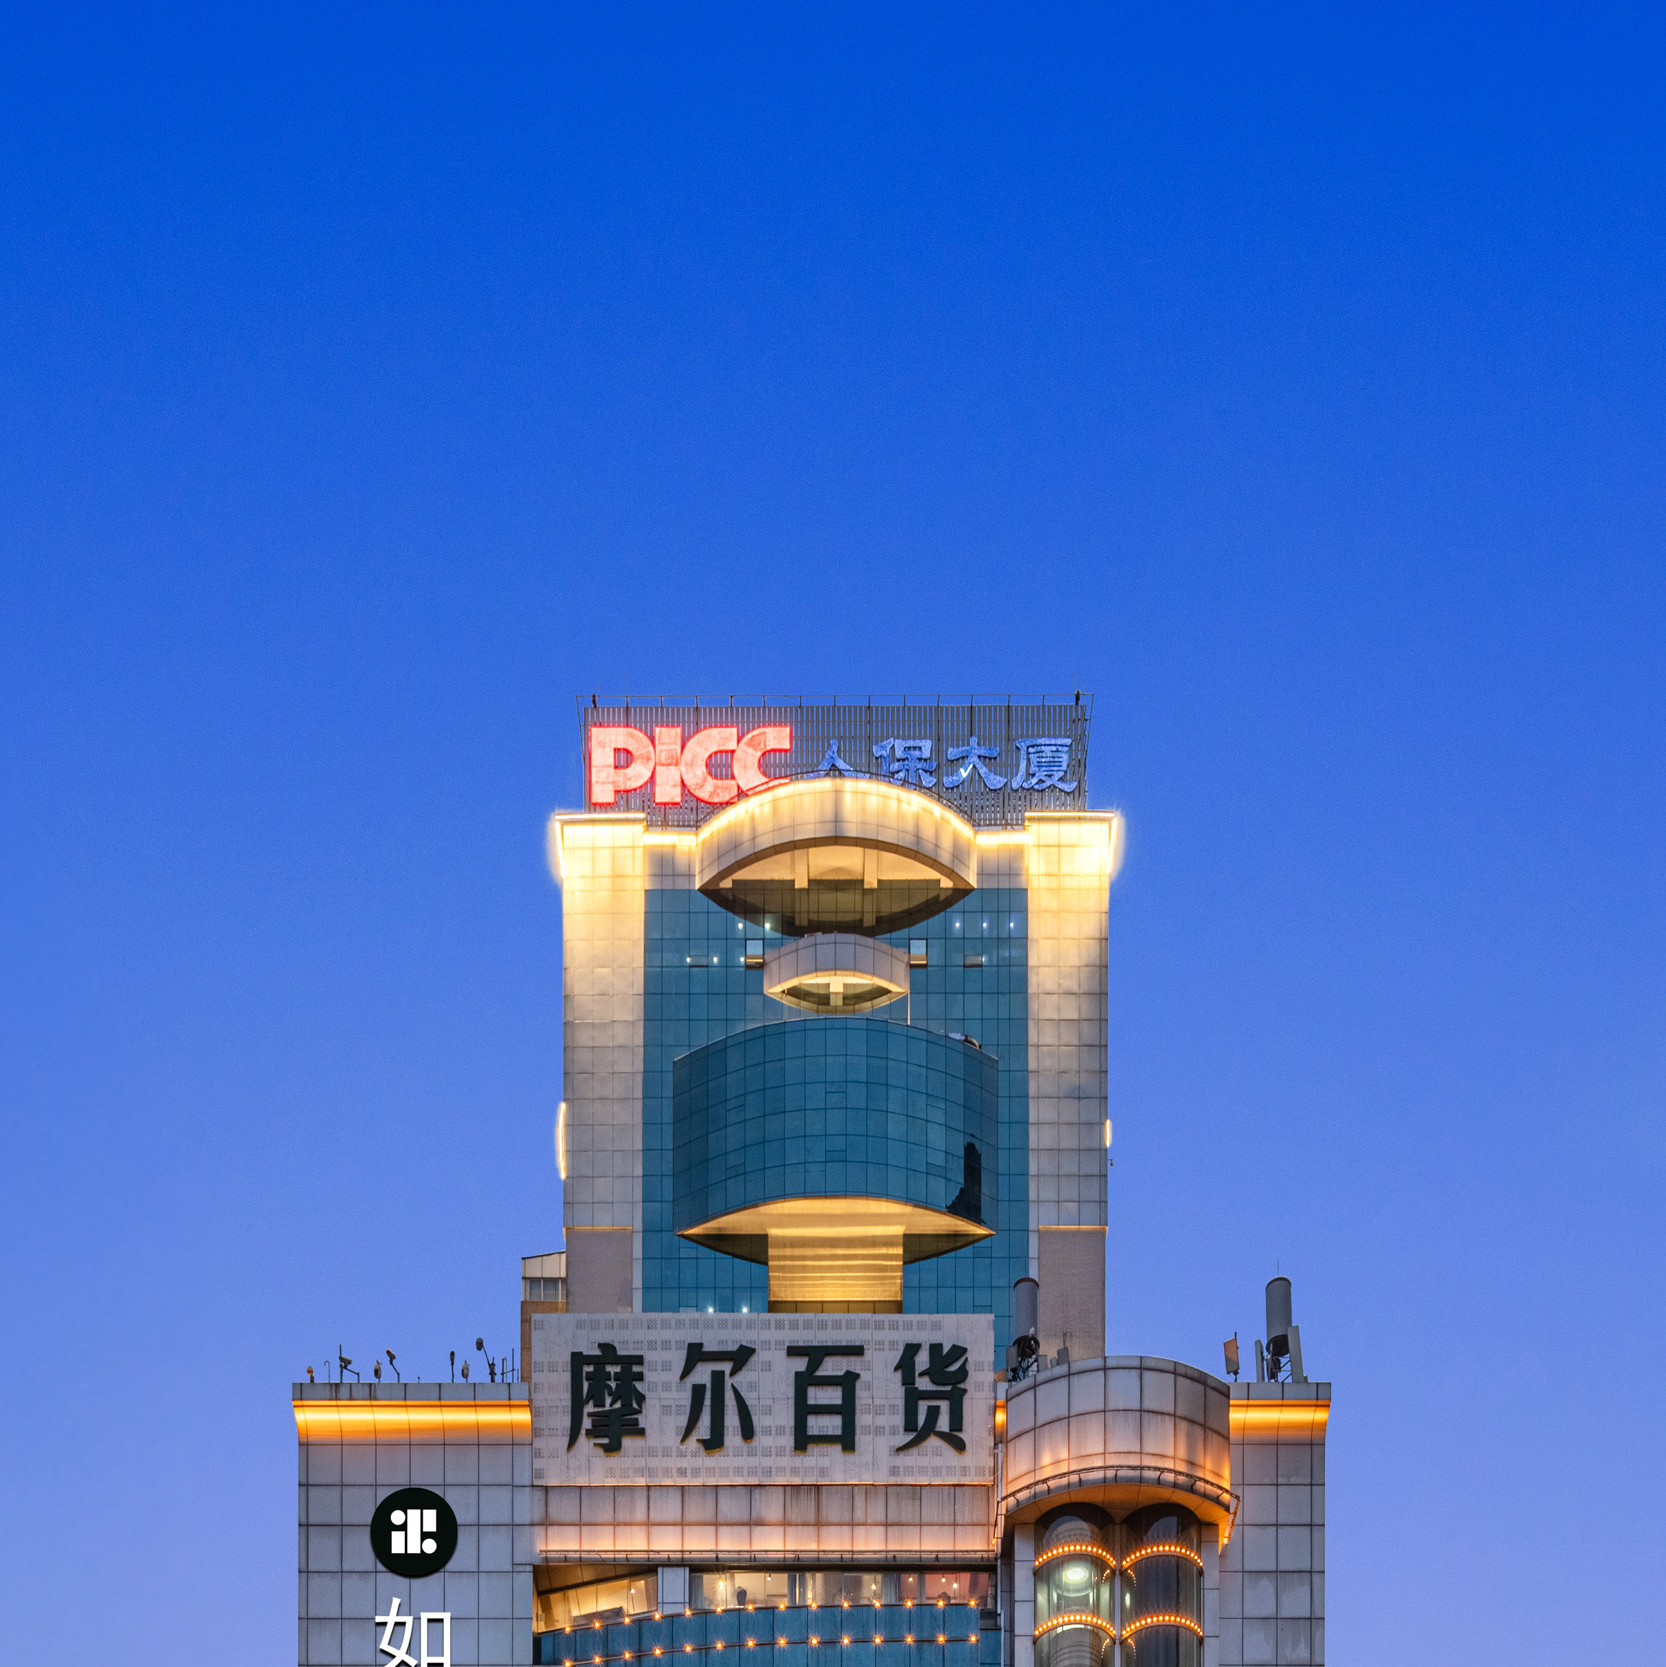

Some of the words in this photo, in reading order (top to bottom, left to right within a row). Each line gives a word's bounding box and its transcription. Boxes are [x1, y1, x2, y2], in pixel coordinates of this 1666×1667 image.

[589, 725, 793, 805] PICC
[806, 736, 1077, 793] 人保大厦
[567, 1342, 970, 1454] 摩尔百货
